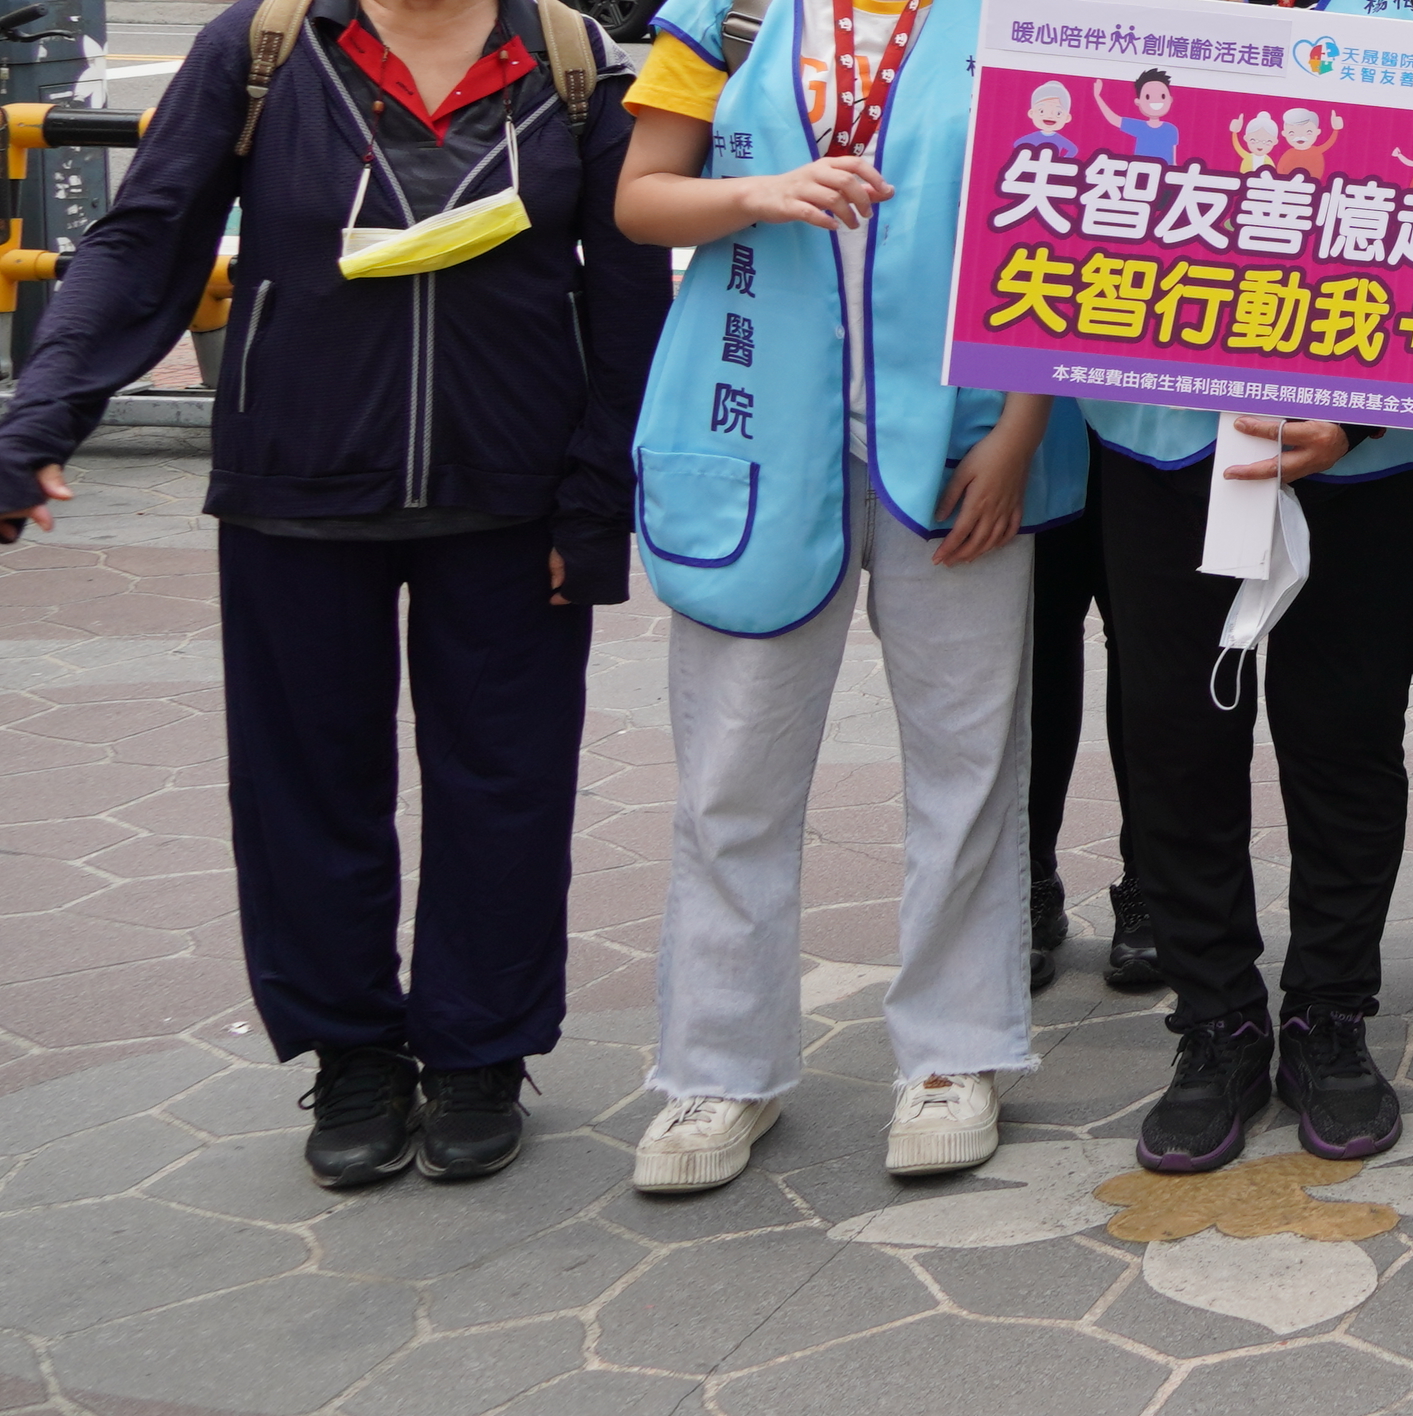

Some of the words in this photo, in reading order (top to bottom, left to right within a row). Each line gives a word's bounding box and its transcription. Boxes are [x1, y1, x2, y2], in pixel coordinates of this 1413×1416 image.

[1141, 35, 1284, 70] 創憶齡活走讀
[713, 131, 754, 160] 中壢
[711, 176, 756, 440] 晟醫院
